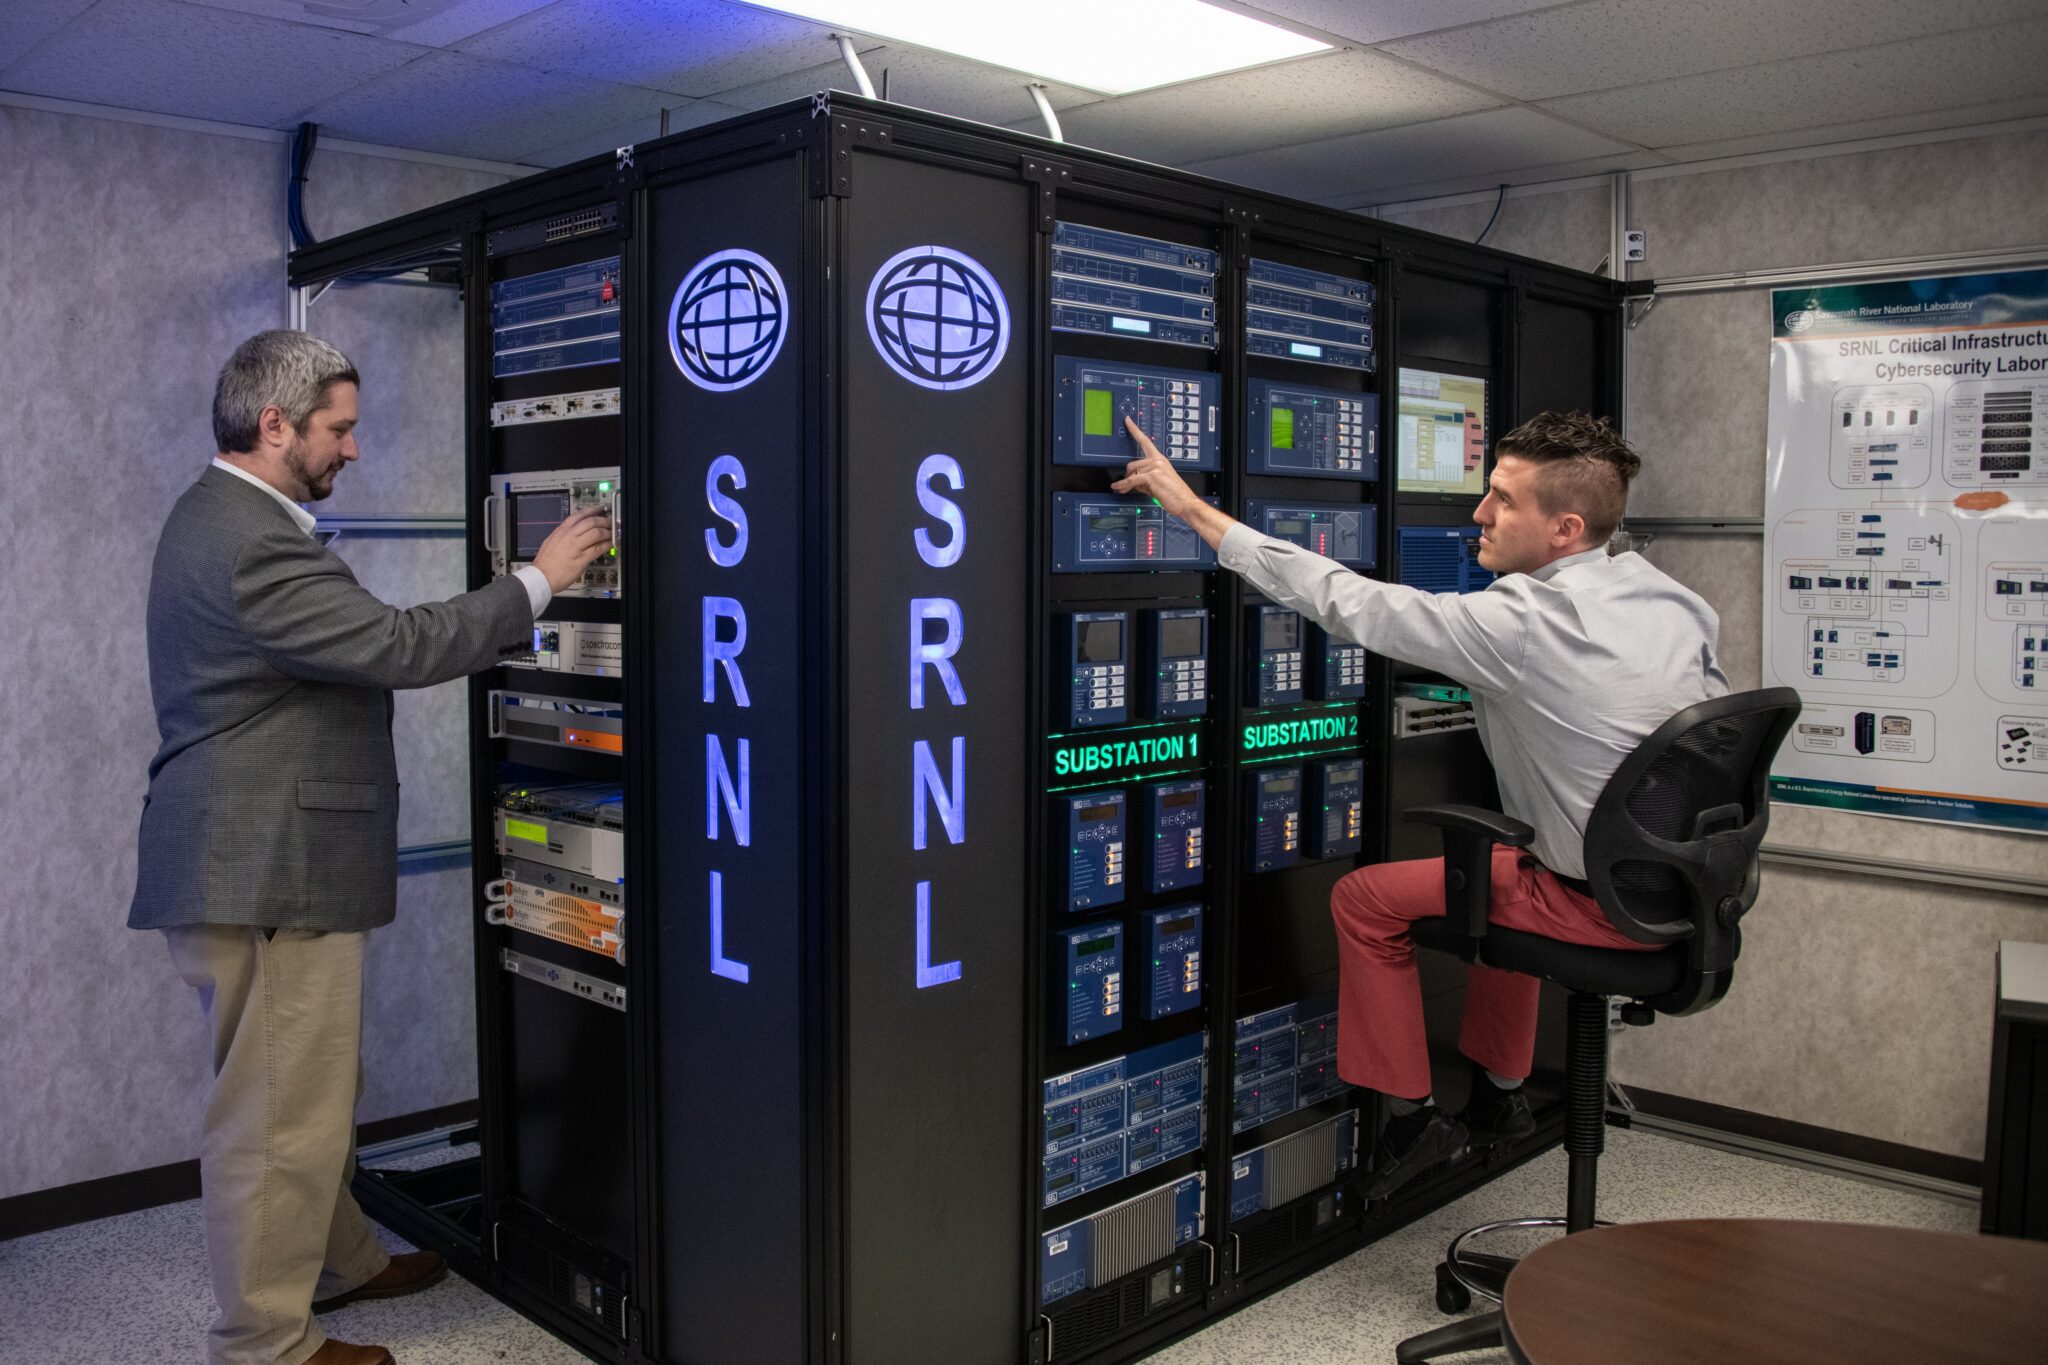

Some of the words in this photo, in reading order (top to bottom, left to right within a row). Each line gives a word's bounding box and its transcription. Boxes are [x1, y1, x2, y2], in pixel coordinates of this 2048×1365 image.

[1859, 306, 1882, 317] River
[1884, 303, 1921, 315] National
[1923, 300, 1974, 312] Laboratory
[1839, 339, 1884, 357] SRNL
[1888, 335, 1946, 354] Critical
[1875, 358, 1991, 382] Cybersecurity
[702, 454, 751, 984] SRNL
[910, 453, 967, 989] SRNL
[1244, 717, 1346, 750] SUBSTATION
[1350, 715, 1358, 736] 2
[1055, 737, 1184, 775] SUBSTATION
[1188, 733, 1198, 757] 1
